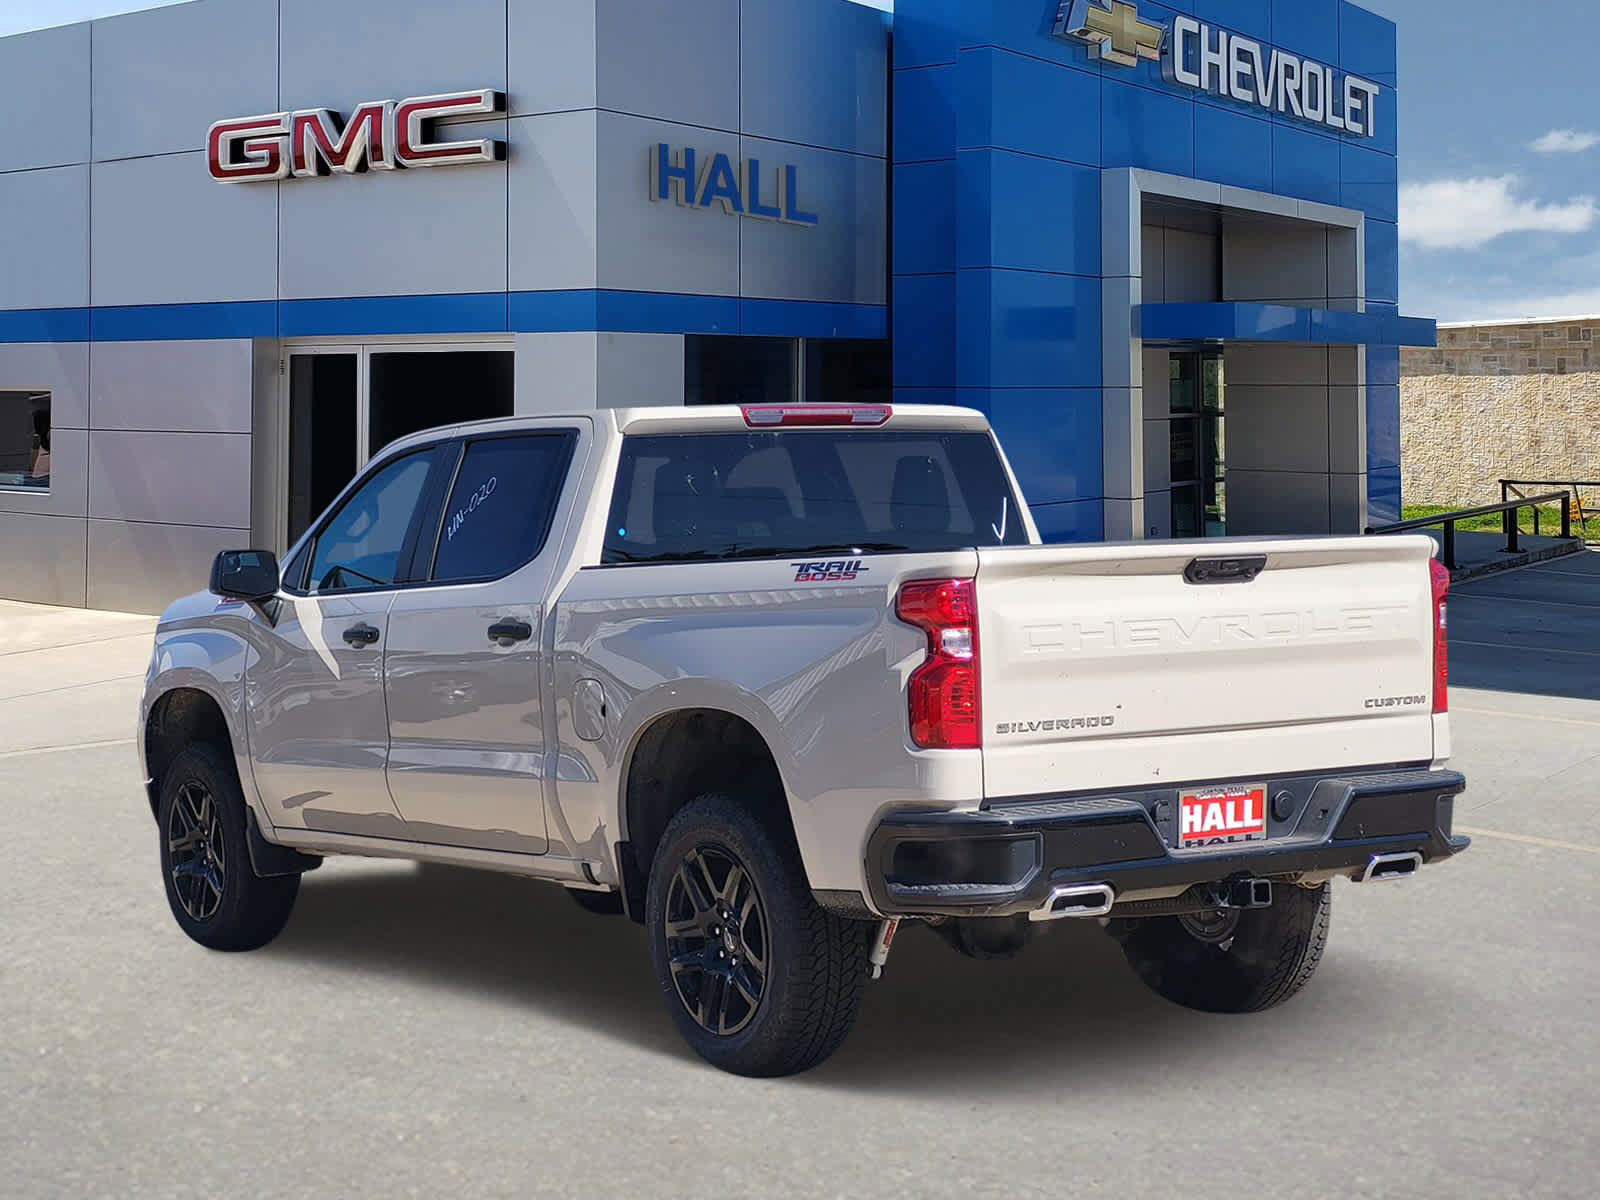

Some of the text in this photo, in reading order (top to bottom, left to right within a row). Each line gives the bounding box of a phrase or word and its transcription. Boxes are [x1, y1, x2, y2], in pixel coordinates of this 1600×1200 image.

[1174, 15, 1380, 137] CHEVROLET
[207, 88, 507, 184] GMC
[656, 143, 819, 226] HALL
[790, 560, 870, 573] TRAIL
[794, 571, 857, 582] BOSS
[1364, 695, 1426, 708] CUSTOM
[996, 715, 1114, 734] SILVERADO
[1182, 799, 1263, 834] HALL
